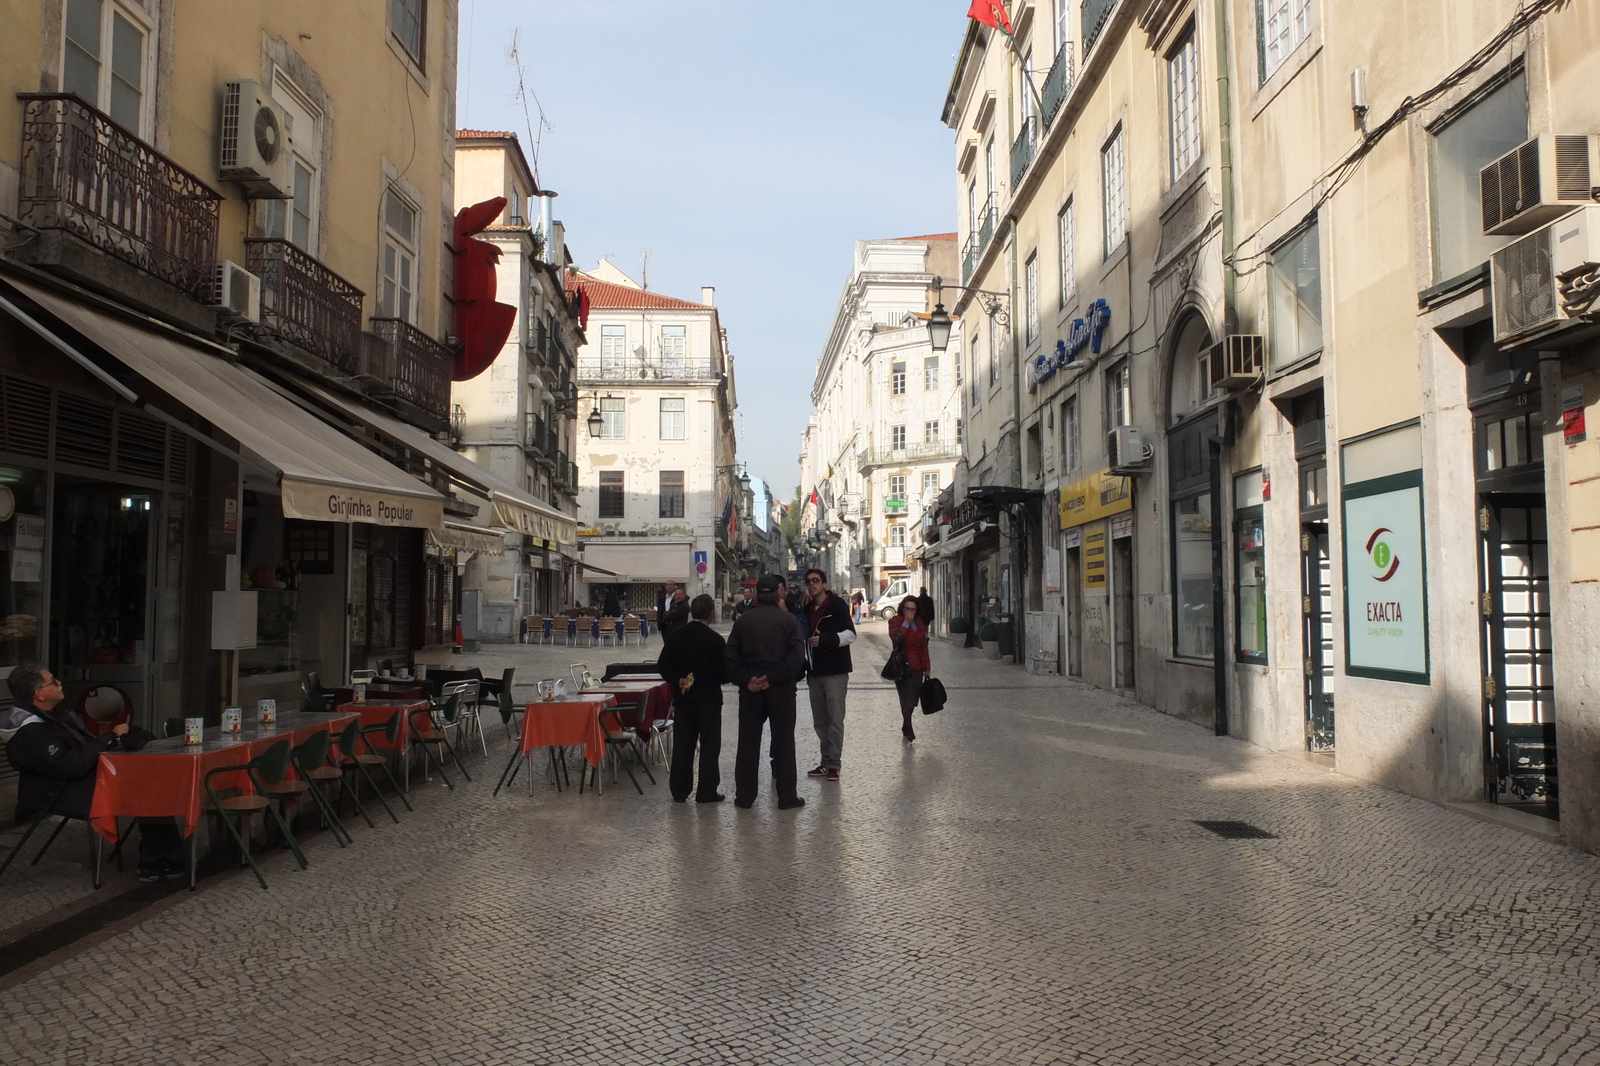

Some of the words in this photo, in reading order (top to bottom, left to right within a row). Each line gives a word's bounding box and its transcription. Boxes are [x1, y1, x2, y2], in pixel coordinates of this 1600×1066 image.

[328, 494, 372, 519] Ginjinha
[378, 501, 414, 523] Popular
[1367, 602, 1403, 622] EXACTA
[1367, 627, 1387, 636] QUALITY
[1387, 628, 1404, 637] VISION
